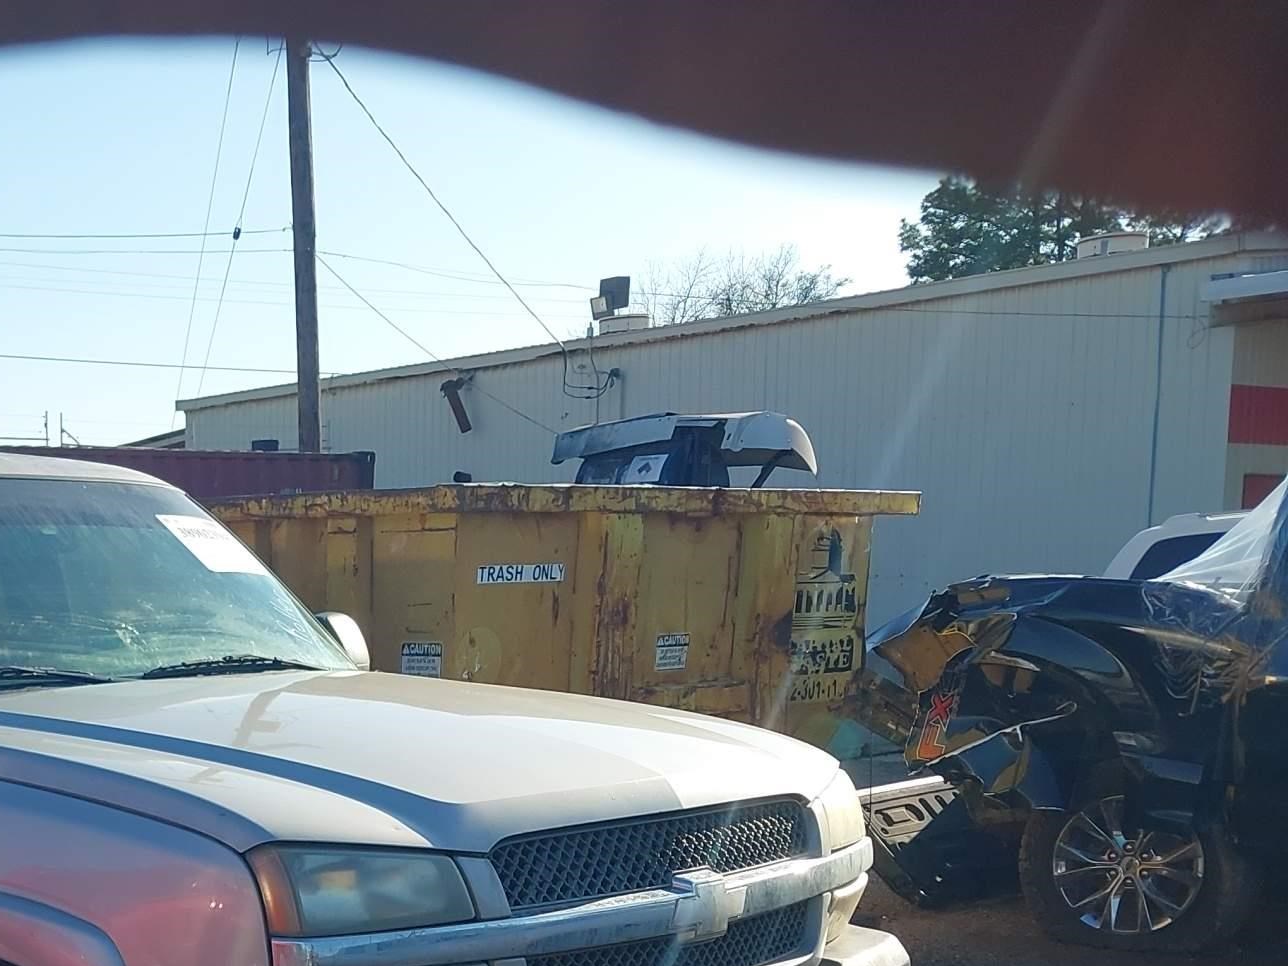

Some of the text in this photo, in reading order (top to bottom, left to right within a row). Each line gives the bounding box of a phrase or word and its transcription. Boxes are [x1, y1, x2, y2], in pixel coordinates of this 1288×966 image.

[479, 564, 565, 582] TRASH ONLY
[410, 643, 441, 655] CAUTION
